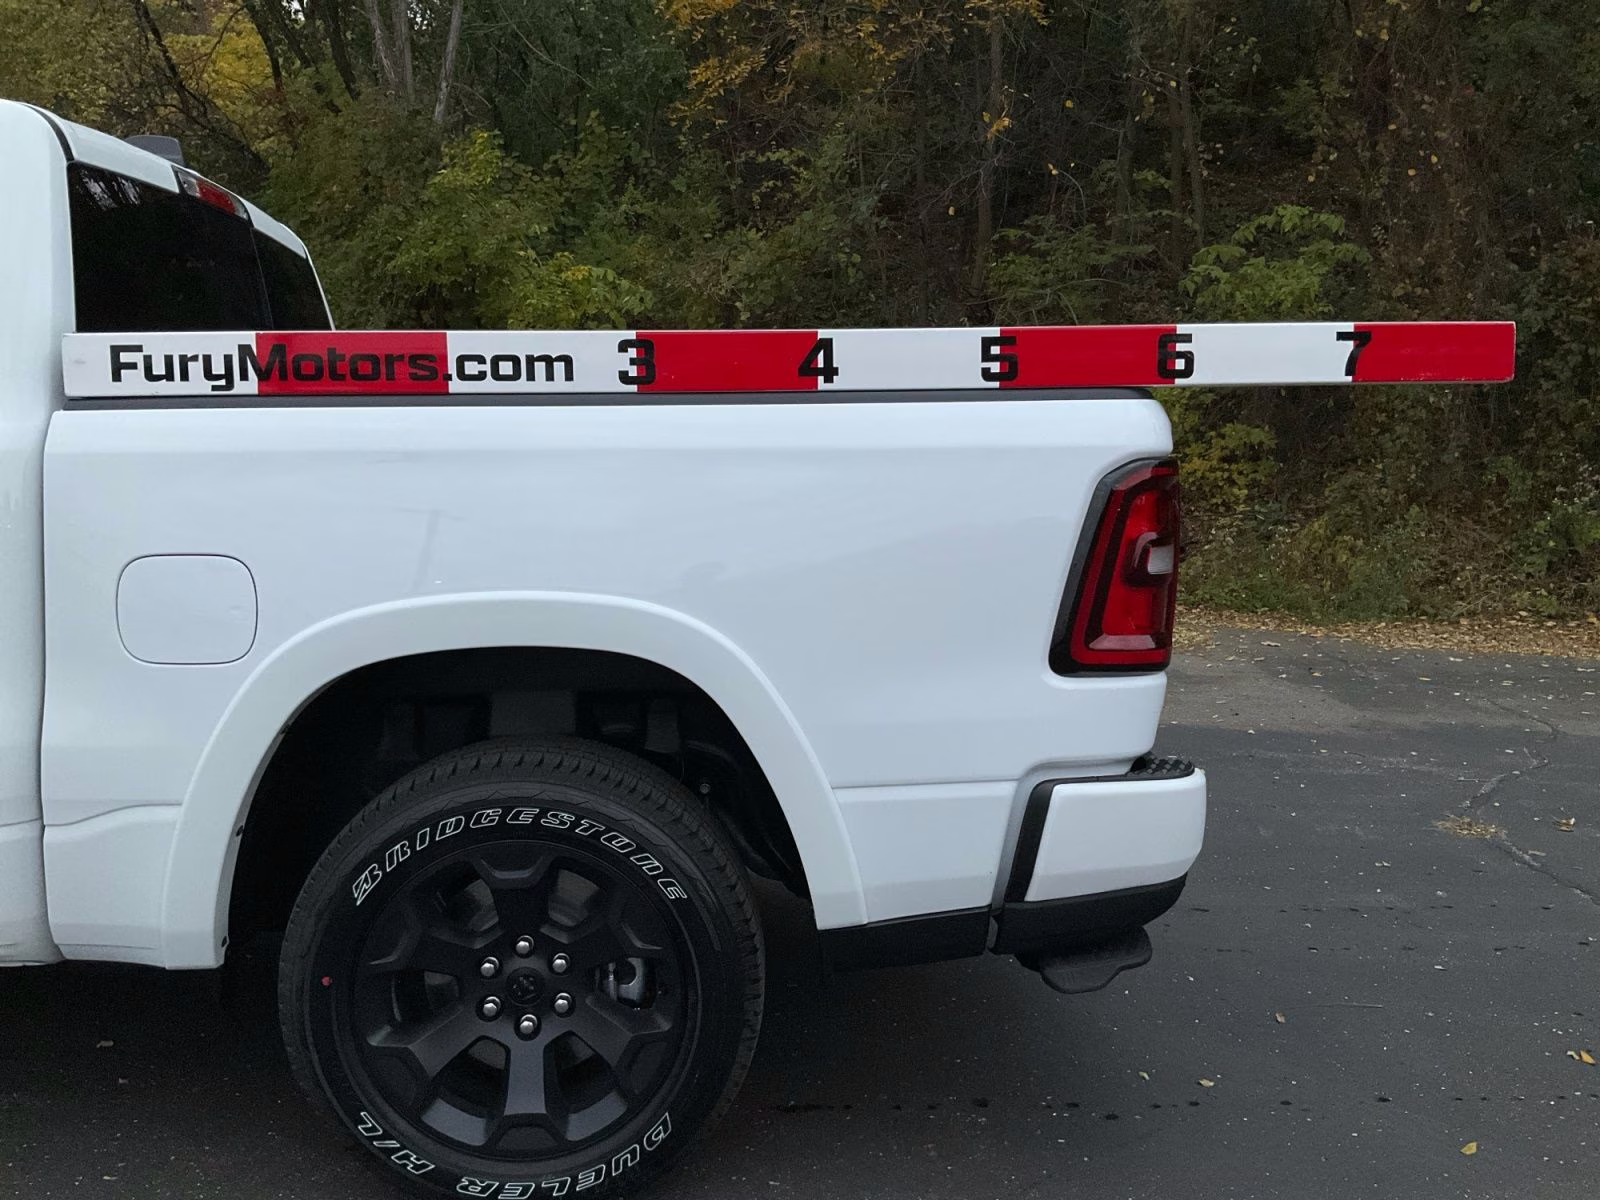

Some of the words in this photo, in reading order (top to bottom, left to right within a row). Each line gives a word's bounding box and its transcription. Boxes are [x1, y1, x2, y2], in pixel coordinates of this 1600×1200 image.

[109, 343, 575, 391] FuryMotors.com
[617, 339, 656, 385] 3
[798, 338, 839, 383] 4
[980, 336, 1018, 382] 5
[1157, 333, 1194, 379] 6
[1336, 331, 1372, 376] 7
[352, 807, 687, 906] BRIDGESTONE
[456, 1111, 672, 1200] DUELER
